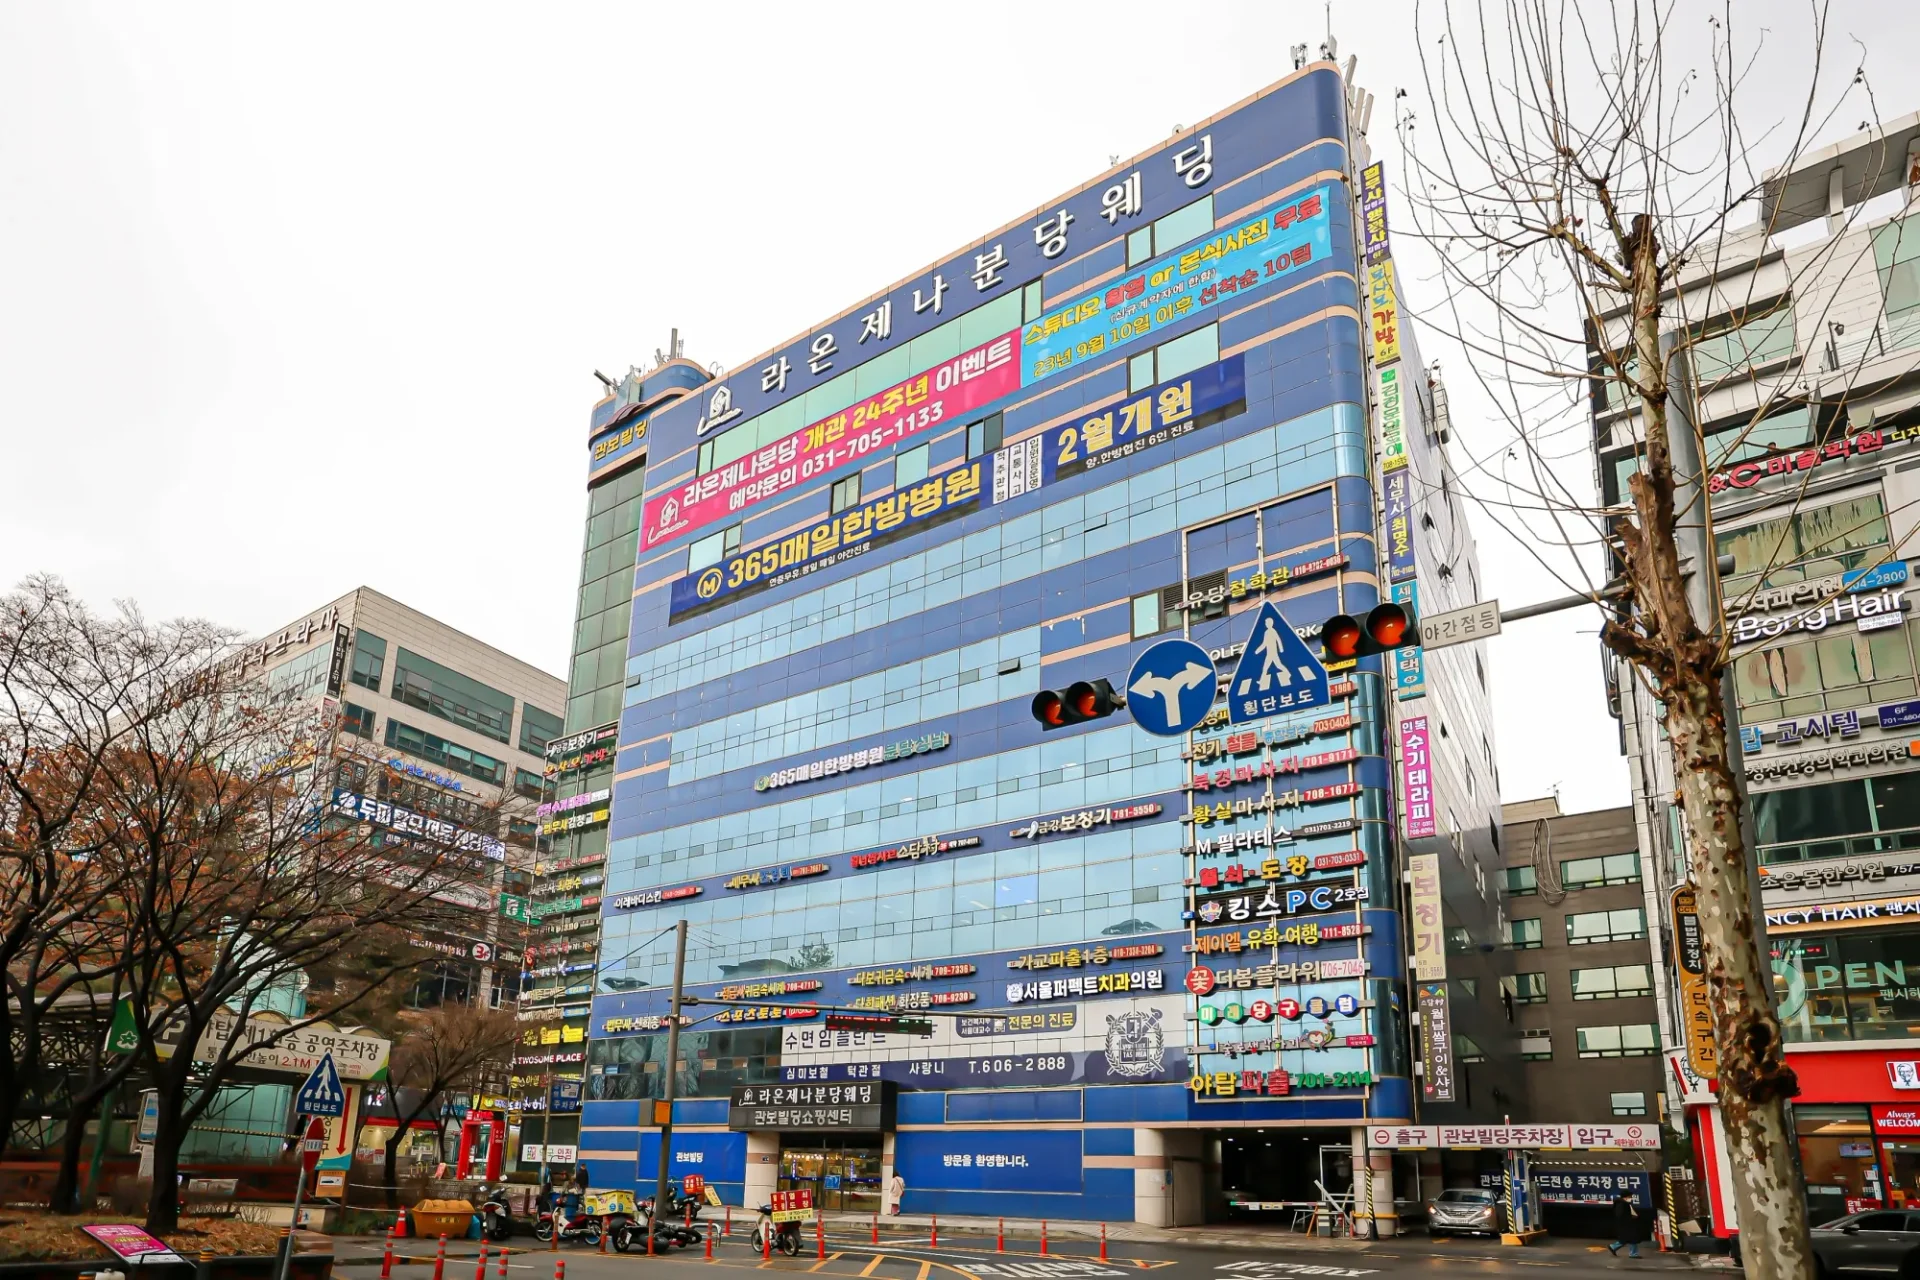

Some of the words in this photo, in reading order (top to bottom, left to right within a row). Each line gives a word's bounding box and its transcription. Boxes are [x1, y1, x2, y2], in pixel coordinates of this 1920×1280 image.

[1024, 297, 1101, 346] 스튜디오
[1150, 264, 1175, 287] or
[1179, 218, 1269, 275] 본식사진
[1273, 194, 1323, 230] 무료
[1034, 348, 1073, 378] 23년
[1076, 334, 1106, 360] 9월
[1109, 315, 1151, 343] 10일
[1156, 296, 1193, 323] 이후
[1199, 269, 1259, 305] 선착순
[1264, 242, 1312, 278] 10팀
[683, 437, 799, 508] 라온제나분당
[803, 414, 848, 453] 개관
[852, 375, 929, 429] 24주년
[935, 337, 1012, 392] 이벤트
[1148, 433, 1168, 446] 6인
[1170, 420, 1195, 438] 진료
[595, 419, 648, 461] 관보빌딩
[1767, 429, 1884, 475] 미술학원
[728, 465, 797, 511] 예약문의
[802, 401, 944, 478] 031-705-1133
[1388, 474, 1407, 516] 세무사
[728, 462, 981, 588] 365매일한방병원
[837, 542, 871, 561] 야간진료
[1229, 566, 1290, 598] 철학관
[1833, 588, 1905, 622] Hair
[1424, 610, 1495, 641] 야간점등
[1243, 689, 1314, 716] 횡단보도
[1894, 706, 1908, 715] 6F
[1776, 710, 1860, 744] 고시텔
[1192, 739, 1221, 760] 전기
[1749, 741, 1907, 781] 정신건강의학과의원
[770, 746, 884, 788] 365매일한방병원
[1193, 755, 1299, 790] 북경마사지
[1060, 808, 1112, 832] 보청기
[1193, 789, 1299, 824] 황실마사지
[1196, 838, 1211, 855] M
[1217, 826, 1293, 853] 필라테스
[1286, 886, 1333, 914] PC
[1334, 886, 1369, 902] 2호점
[1822, 904, 1879, 923] HAIR
[1414, 875, 1441, 955] 보청기
[1196, 931, 1241, 955] 제이엘
[1024, 969, 1163, 1000] 서울퍼펙트치과의원
[1190, 969, 1210, 991] 꽃
[1216, 961, 1320, 988] 더봄플라워
[1008, 1013, 1045, 1031] 전문의
[1048, 1012, 1075, 1028] 진료
[305, 1034, 380, 1061] 공영주차장
[518, 1054, 554, 1065] TWOSOME
[556, 1053, 581, 1062] PLACE
[281, 1056, 311, 1070] 2.1M
[786, 1066, 829, 1080] 심미보철
[847, 1064, 881, 1078] 턱관절
[909, 1062, 945, 1075] 사랑니
[1296, 1071, 1372, 1089] 701-2114
[759, 1085, 872, 1105] 라온제나분당웨딩
[754, 1109, 852, 1126] 관보빌딩쇼핑센터
[1886, 1110, 1916, 1119] Always
[1395, 1129, 1428, 1145] 출구
[1444, 1128, 1564, 1146] 관보빌딩주차장
[1577, 1129, 1613, 1146] 입구
[1614, 1138, 1643, 1148] 제한높이
[1645, 1139, 1657, 1147] 2M
[676, 1152, 704, 1163] 관보빌딩
[943, 1155, 972, 1167] 방문을
[975, 1155, 1029, 1167] 환영합니다.
[1578, 1176, 1612, 1189] 주차장
[1617, 1176, 1641, 1189] 입구
